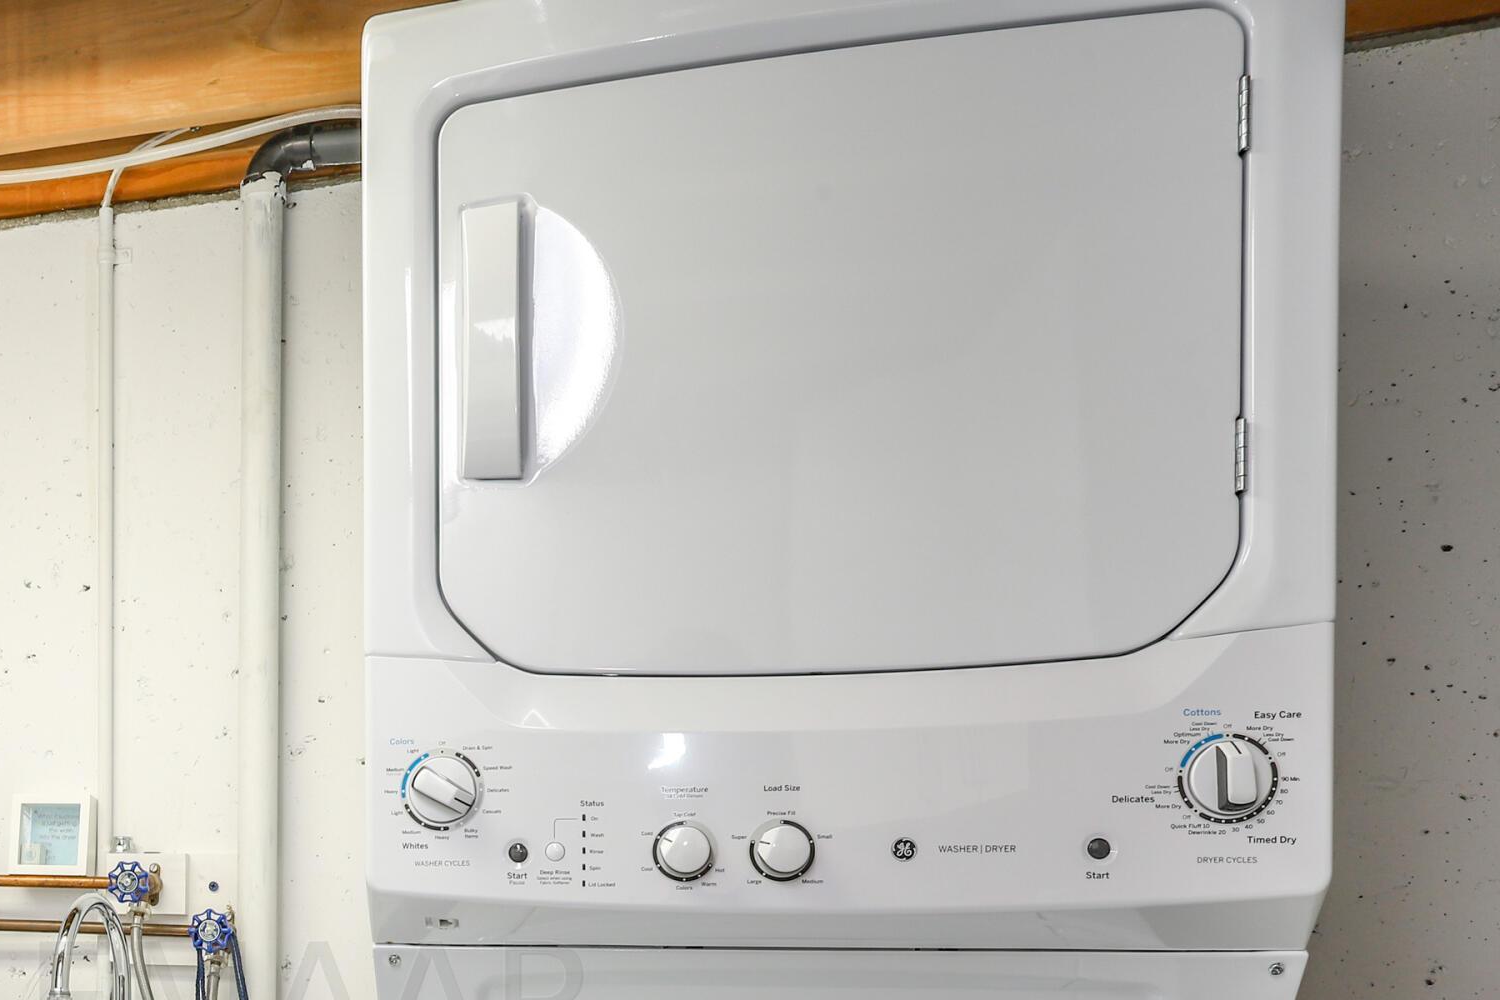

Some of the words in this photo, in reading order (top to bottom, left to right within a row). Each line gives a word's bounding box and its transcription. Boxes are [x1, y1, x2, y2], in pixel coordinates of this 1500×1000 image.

[1183, 708, 1221, 716] Cottons
[1254, 711, 1277, 720] Easy
[1278, 710, 1302, 719] Care
[389, 738, 415, 746] Colors
[661, 785, 709, 793] Temperature
[763, 784, 782, 792] Load
[783, 784, 801, 792] Size
[580, 799, 605, 807] Status
[1111, 795, 1155, 804] Delicates
[1247, 835, 1277, 844] Timed
[1279, 835, 1297, 845] Dry
[402, 842, 429, 850] Whites
[938, 844, 979, 853] WASHER
[984, 844, 1016, 853] DRYER
[507, 872, 528, 880] Start
[1085, 871, 1109, 879] Start
